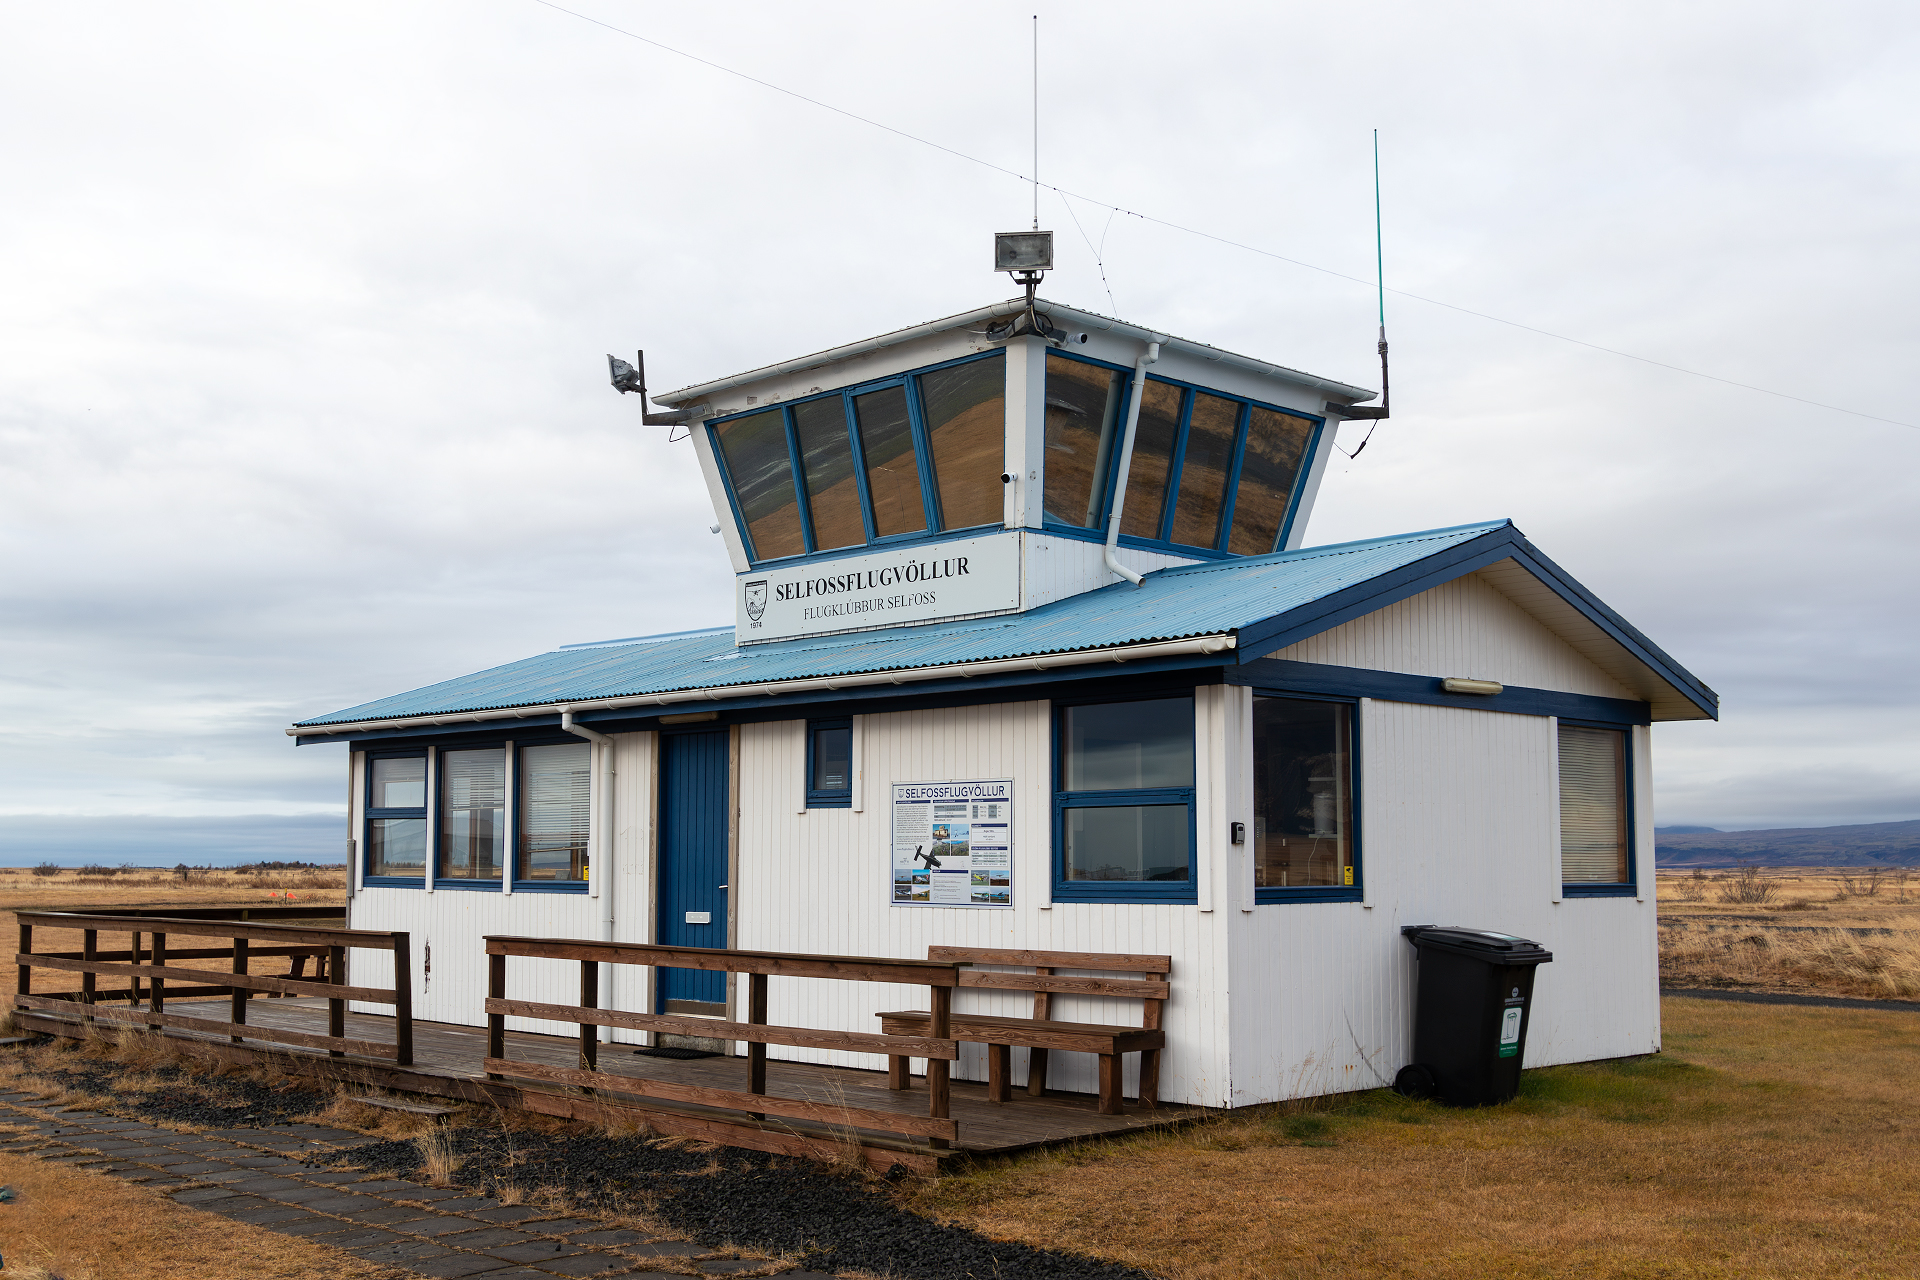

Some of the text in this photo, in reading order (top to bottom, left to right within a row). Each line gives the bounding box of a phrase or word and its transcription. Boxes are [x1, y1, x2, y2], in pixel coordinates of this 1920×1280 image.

[775, 556, 970, 602] SELFOSSFLUGVÖLLUR
[804, 591, 936, 620] FLUGKLÚBBUR SELFOSS
[750, 621, 762, 629] 1974
[905, 784, 1005, 798] SELFOSSFLUGVÖLLUR
